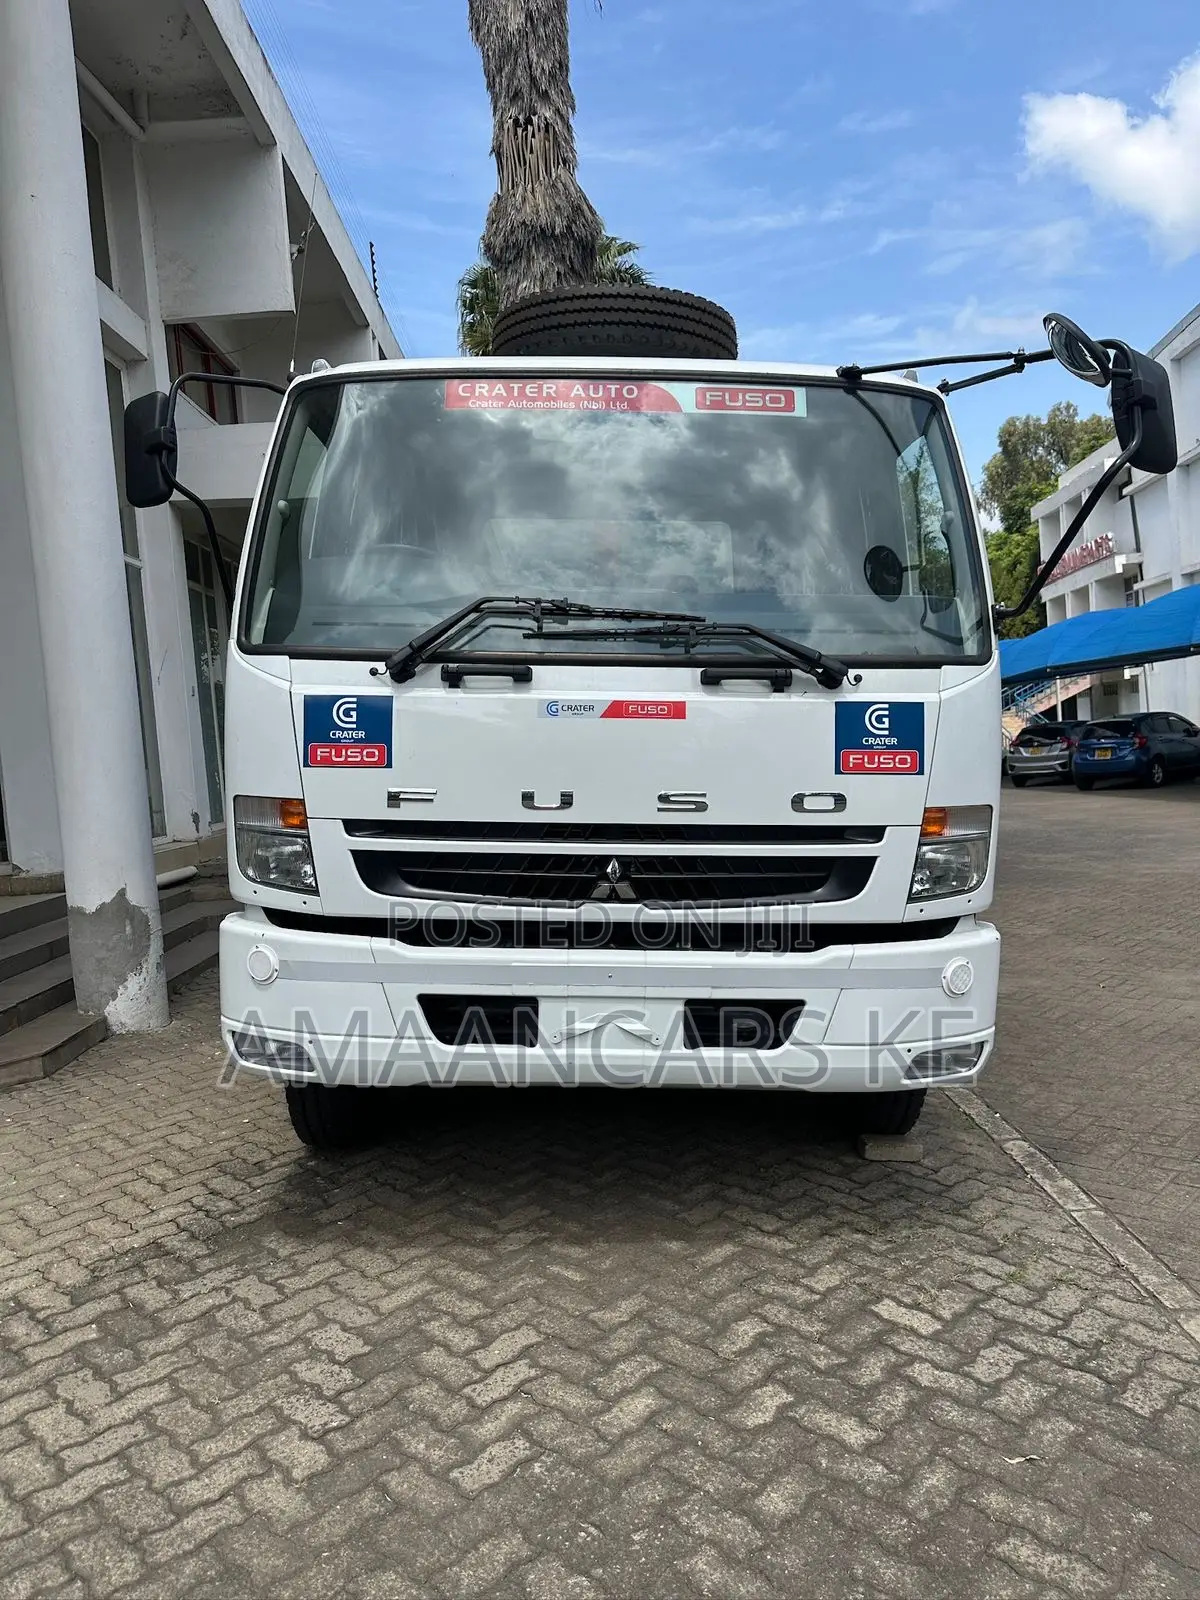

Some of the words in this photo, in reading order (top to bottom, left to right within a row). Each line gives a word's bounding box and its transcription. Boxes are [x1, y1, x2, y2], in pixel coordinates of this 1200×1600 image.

[458, 383, 557, 397] CRATER
[570, 384, 639, 398] AUTO
[468, 399, 504, 408] Crater
[507, 400, 576, 409] Automobiles
[610, 401, 630, 410] Ltd.
[705, 391, 786, 408] FUSO
[561, 704, 595, 712] CRATER
[628, 705, 668, 714] FUSO
[329, 730, 366, 739] CRATER
[862, 737, 898, 745] CRATER
[316, 748, 379, 762] FUSO
[849, 755, 911, 768] FUSO
[387, 788, 848, 813] FUSO
